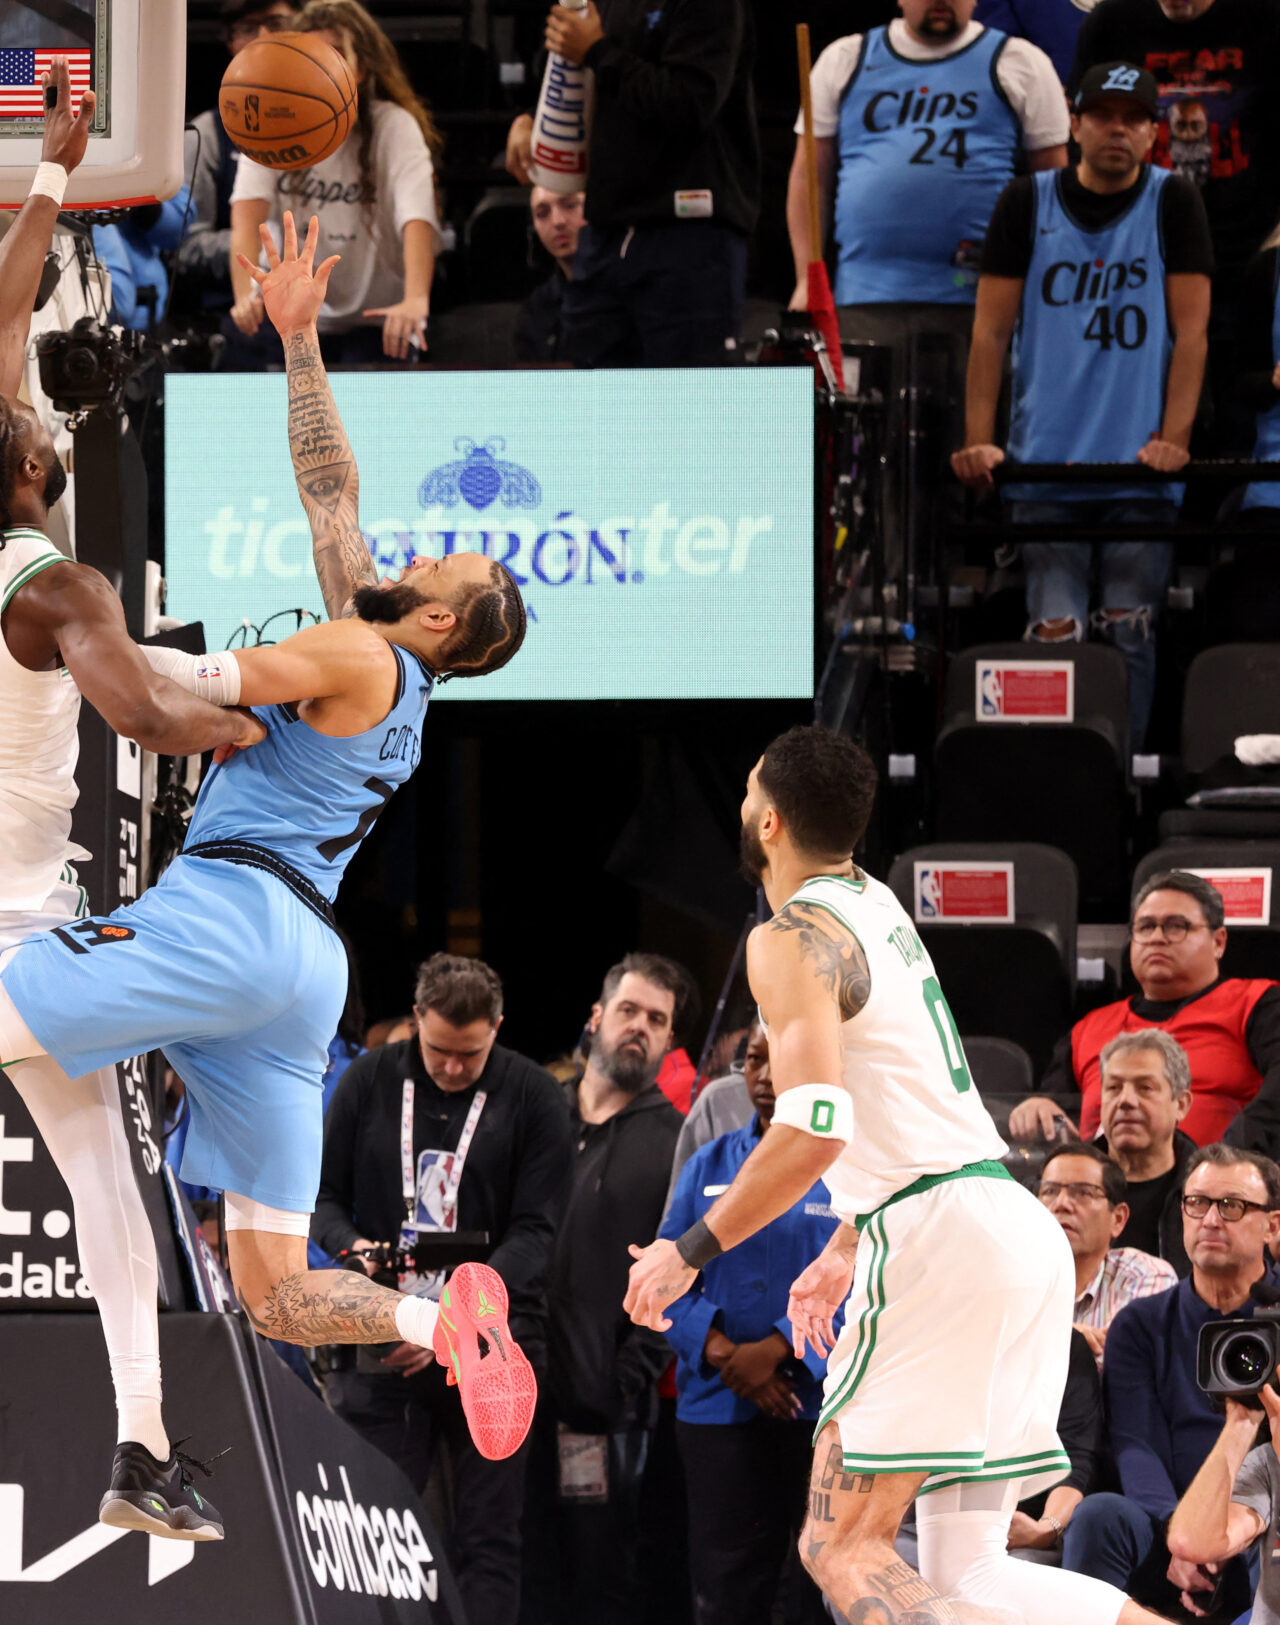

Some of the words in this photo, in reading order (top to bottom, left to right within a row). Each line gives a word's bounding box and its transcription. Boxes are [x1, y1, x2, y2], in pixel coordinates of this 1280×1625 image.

[1145, 49, 1244, 72] FEAR
[863, 86, 979, 134] Clips
[909, 128, 969, 169] 24
[1042, 258, 1147, 307] Clips
[1083, 304, 1148, 351] 40
[315, 775, 395, 864] 7
[922, 976, 971, 1094] 0
[811, 1100, 835, 1133] 0
[296, 1462, 438, 1603] coinbase
